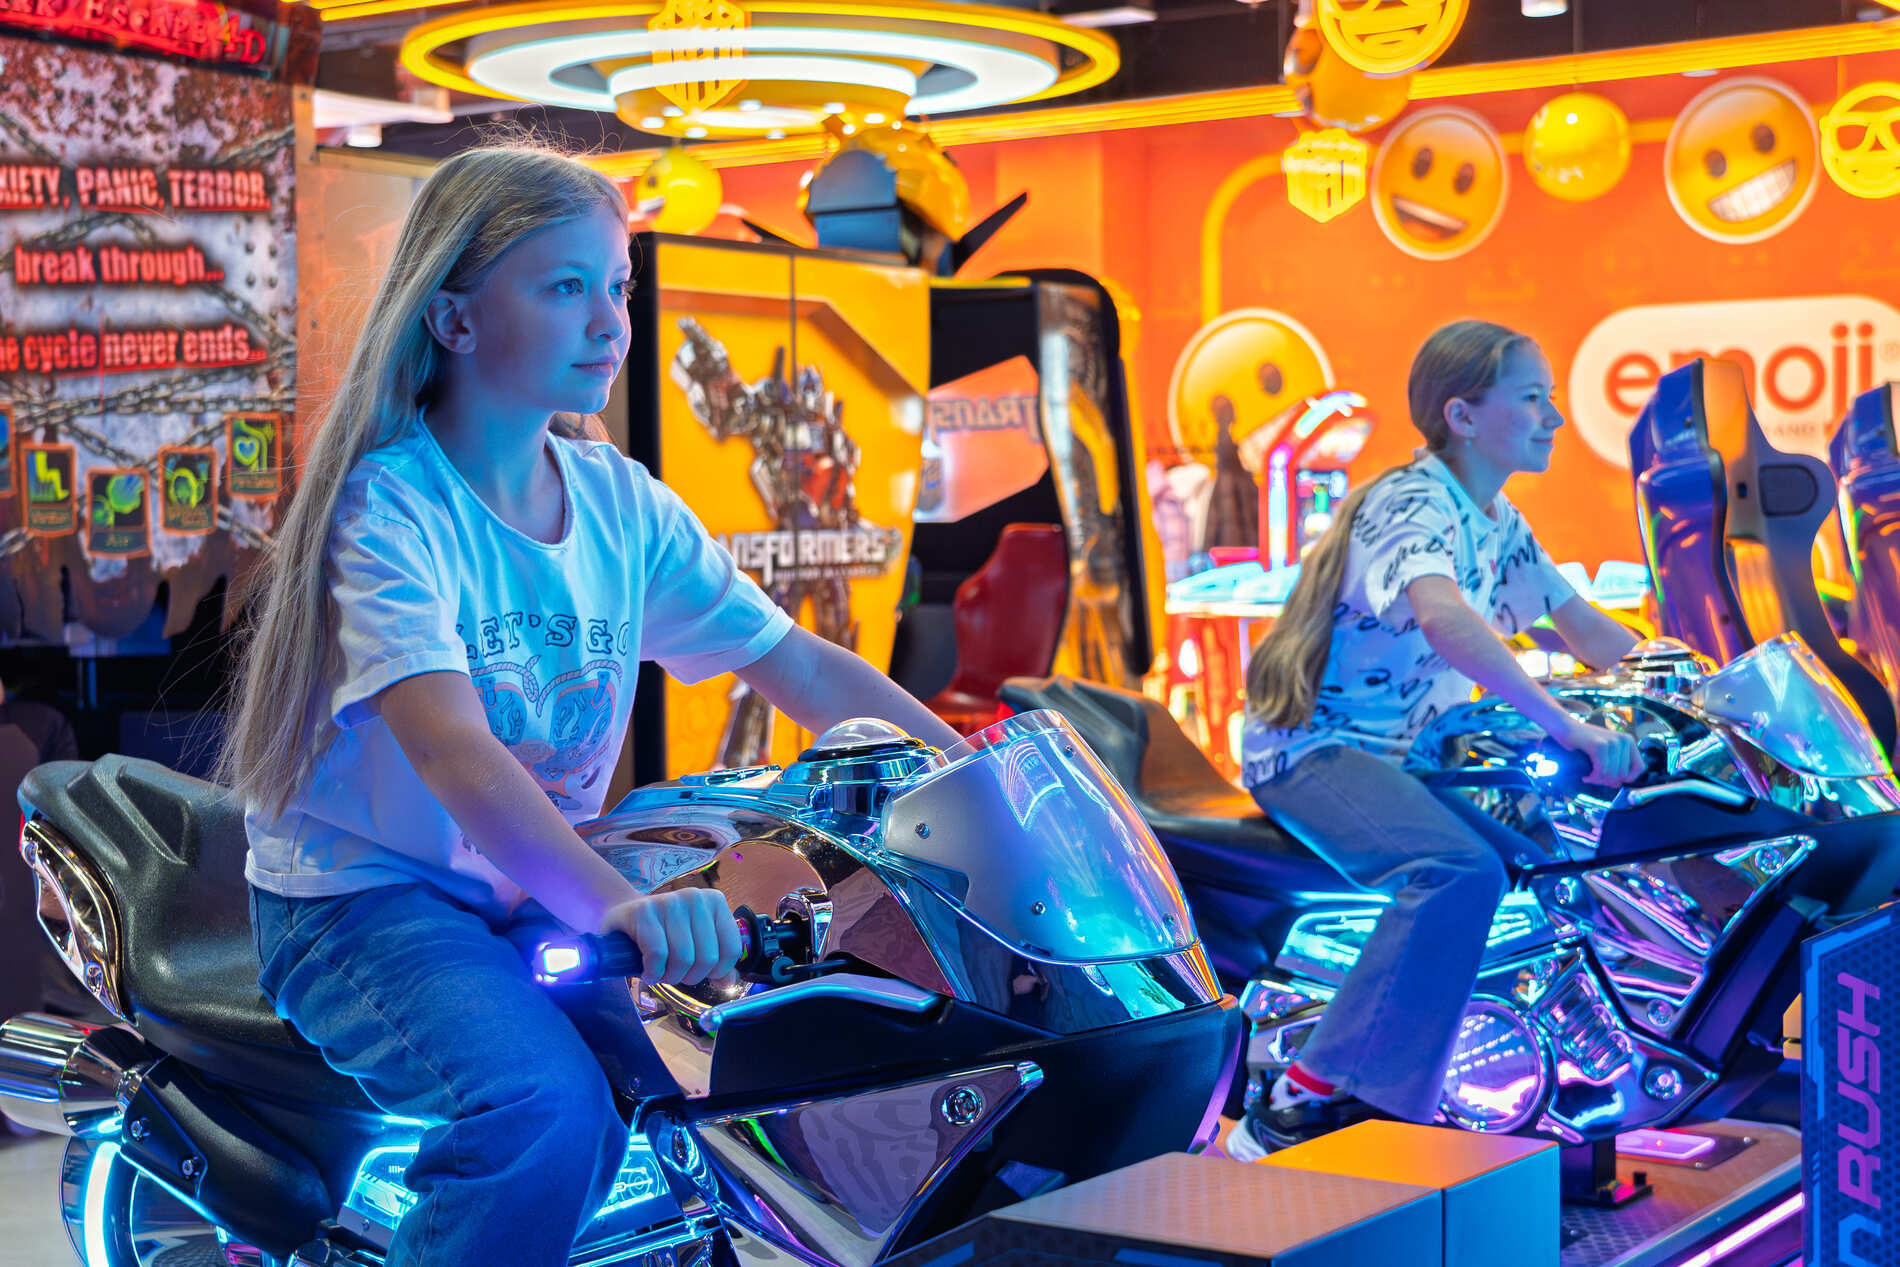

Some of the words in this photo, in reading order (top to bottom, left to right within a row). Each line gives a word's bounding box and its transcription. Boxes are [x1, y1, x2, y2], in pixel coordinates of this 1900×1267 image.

[217, 15, 267, 63] 4D
[76, 167, 164, 208] PANIC,
[15, 246, 96, 283] break
[100, 246, 224, 284] through...
[23, 328, 97, 373] cycle
[103, 332, 178, 366] never
[183, 324, 266, 362] ends...
[1838, 972, 1881, 1210] RUSH
